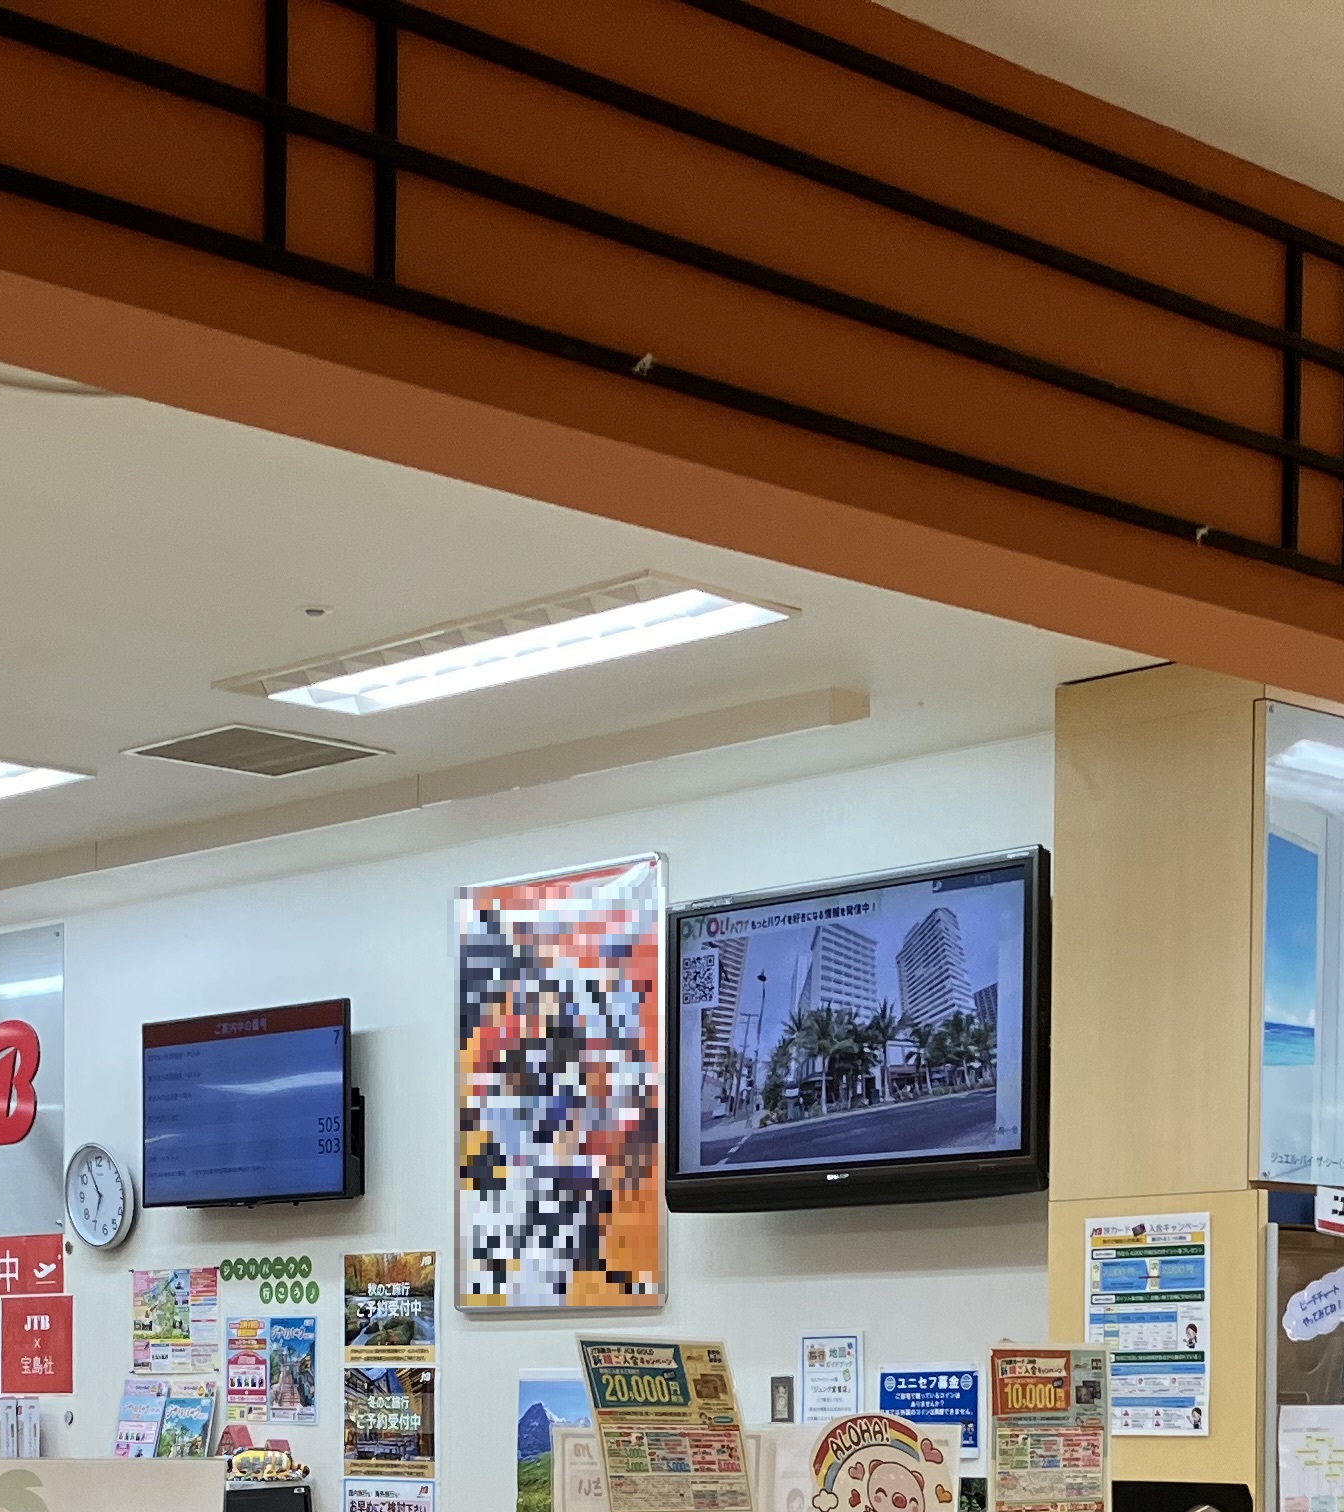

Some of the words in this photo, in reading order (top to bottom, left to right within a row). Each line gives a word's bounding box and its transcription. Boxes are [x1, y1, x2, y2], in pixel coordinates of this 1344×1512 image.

[317, 1116, 341, 1133] 505
[317, 1138, 341, 1155] 503
[367, 1282, 411, 1297] 秋のご旅行
[356, 1300, 422, 1318] ご予約受付中
[24, 1315, 51, 1331] JTB
[20, 1356, 55, 1376] 宝島社
[897, 1376, 959, 1389] ユニセフ募金
[367, 1395, 411, 1410] 冬のご旅行
[356, 1414, 422, 1430] ご予約受付中
[829, 1416, 892, 1459] ALOHA!
